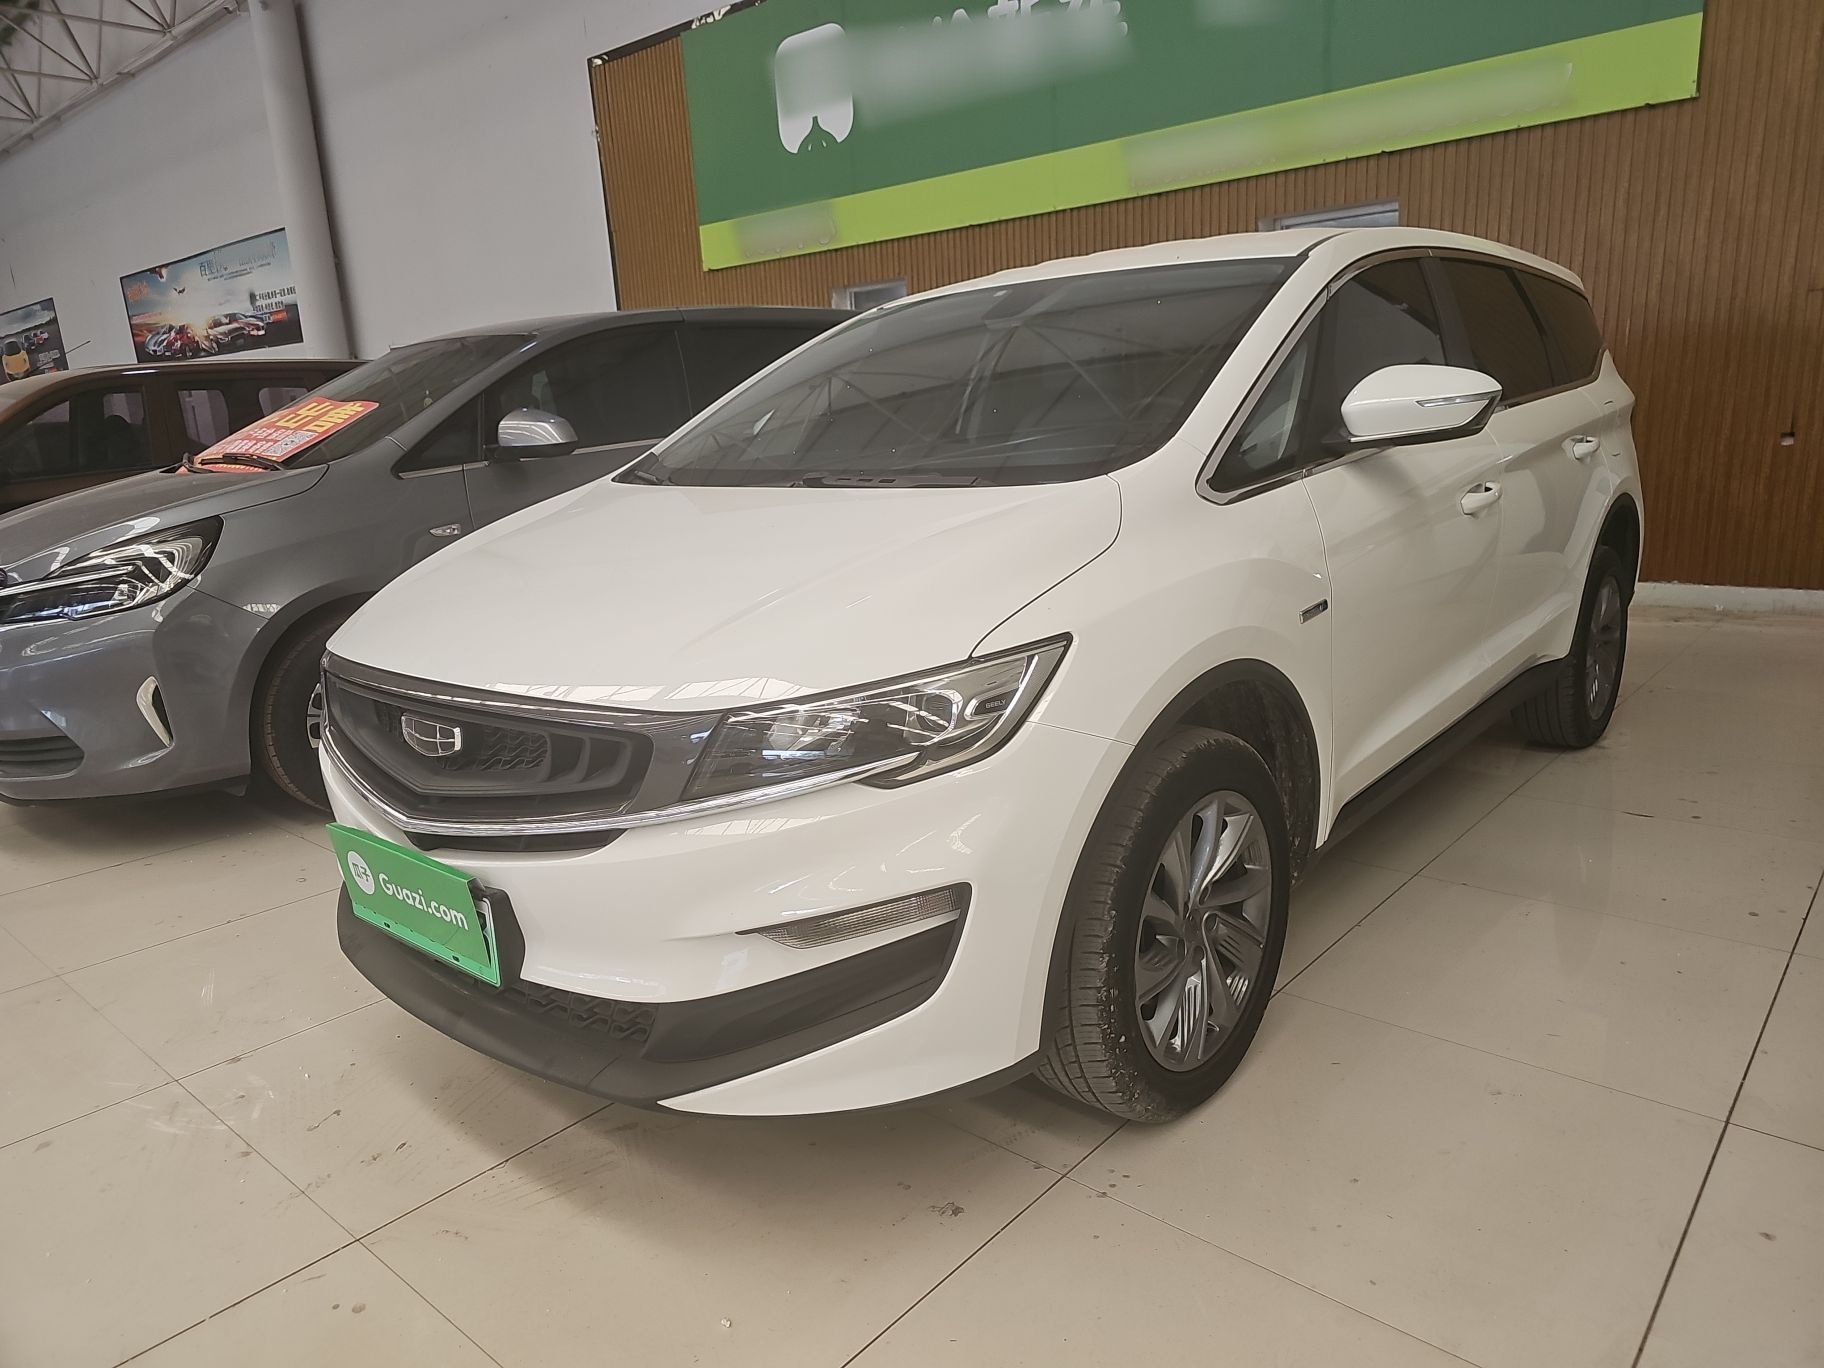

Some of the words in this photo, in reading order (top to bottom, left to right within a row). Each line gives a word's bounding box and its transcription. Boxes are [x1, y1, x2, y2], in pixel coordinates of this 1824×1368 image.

[274, 401, 365, 433] 出售
[985, 699, 1006, 709] GEELY
[378, 873, 469, 931] Guazi.com
